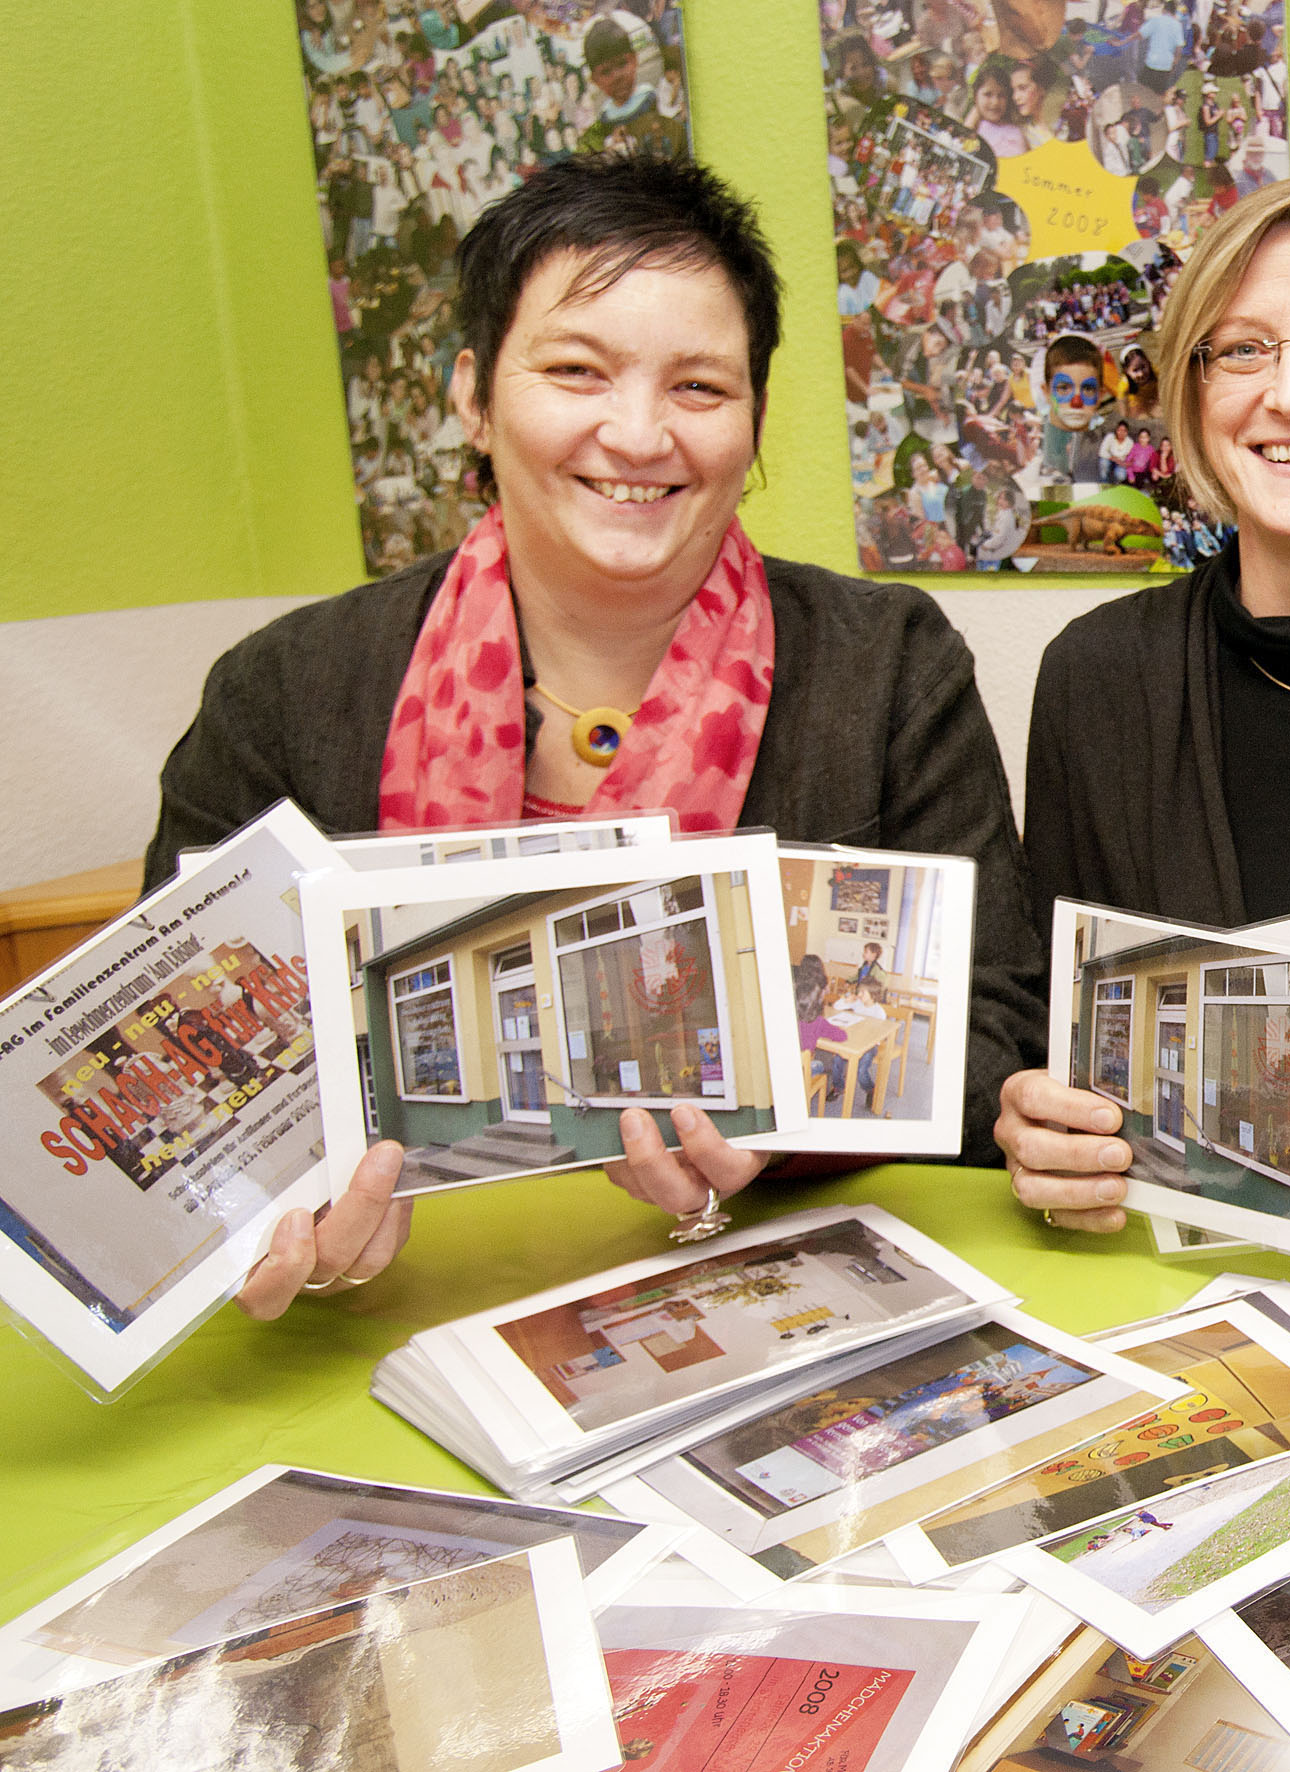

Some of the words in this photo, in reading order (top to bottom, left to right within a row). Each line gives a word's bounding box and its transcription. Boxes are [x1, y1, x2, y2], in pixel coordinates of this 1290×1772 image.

[1023, 166, 1092, 196] Sommer
[0, 1034, 24, 1061] -AG
[26, 1016, 45, 1037] im
[44, 935, 159, 1021] Familienzentrum
[159, 919, 183, 938] Am
[183, 868, 251, 920] Stadtwald
[64, 968, 155, 1052] Bewohnerzentrum
[40, 1024, 222, 1176] SCHACH-AG
[201, 1001, 264, 1049] für
[238, 953, 309, 1018] Kids
[61, 1052, 111, 1096] neu
[124, 999, 175, 1039] neu
[190, 954, 241, 991] neu
[141, 1129, 194, 1172] neu
[212, 1080, 264, 1121] neu
[799, 1668, 840, 1715] 2008
